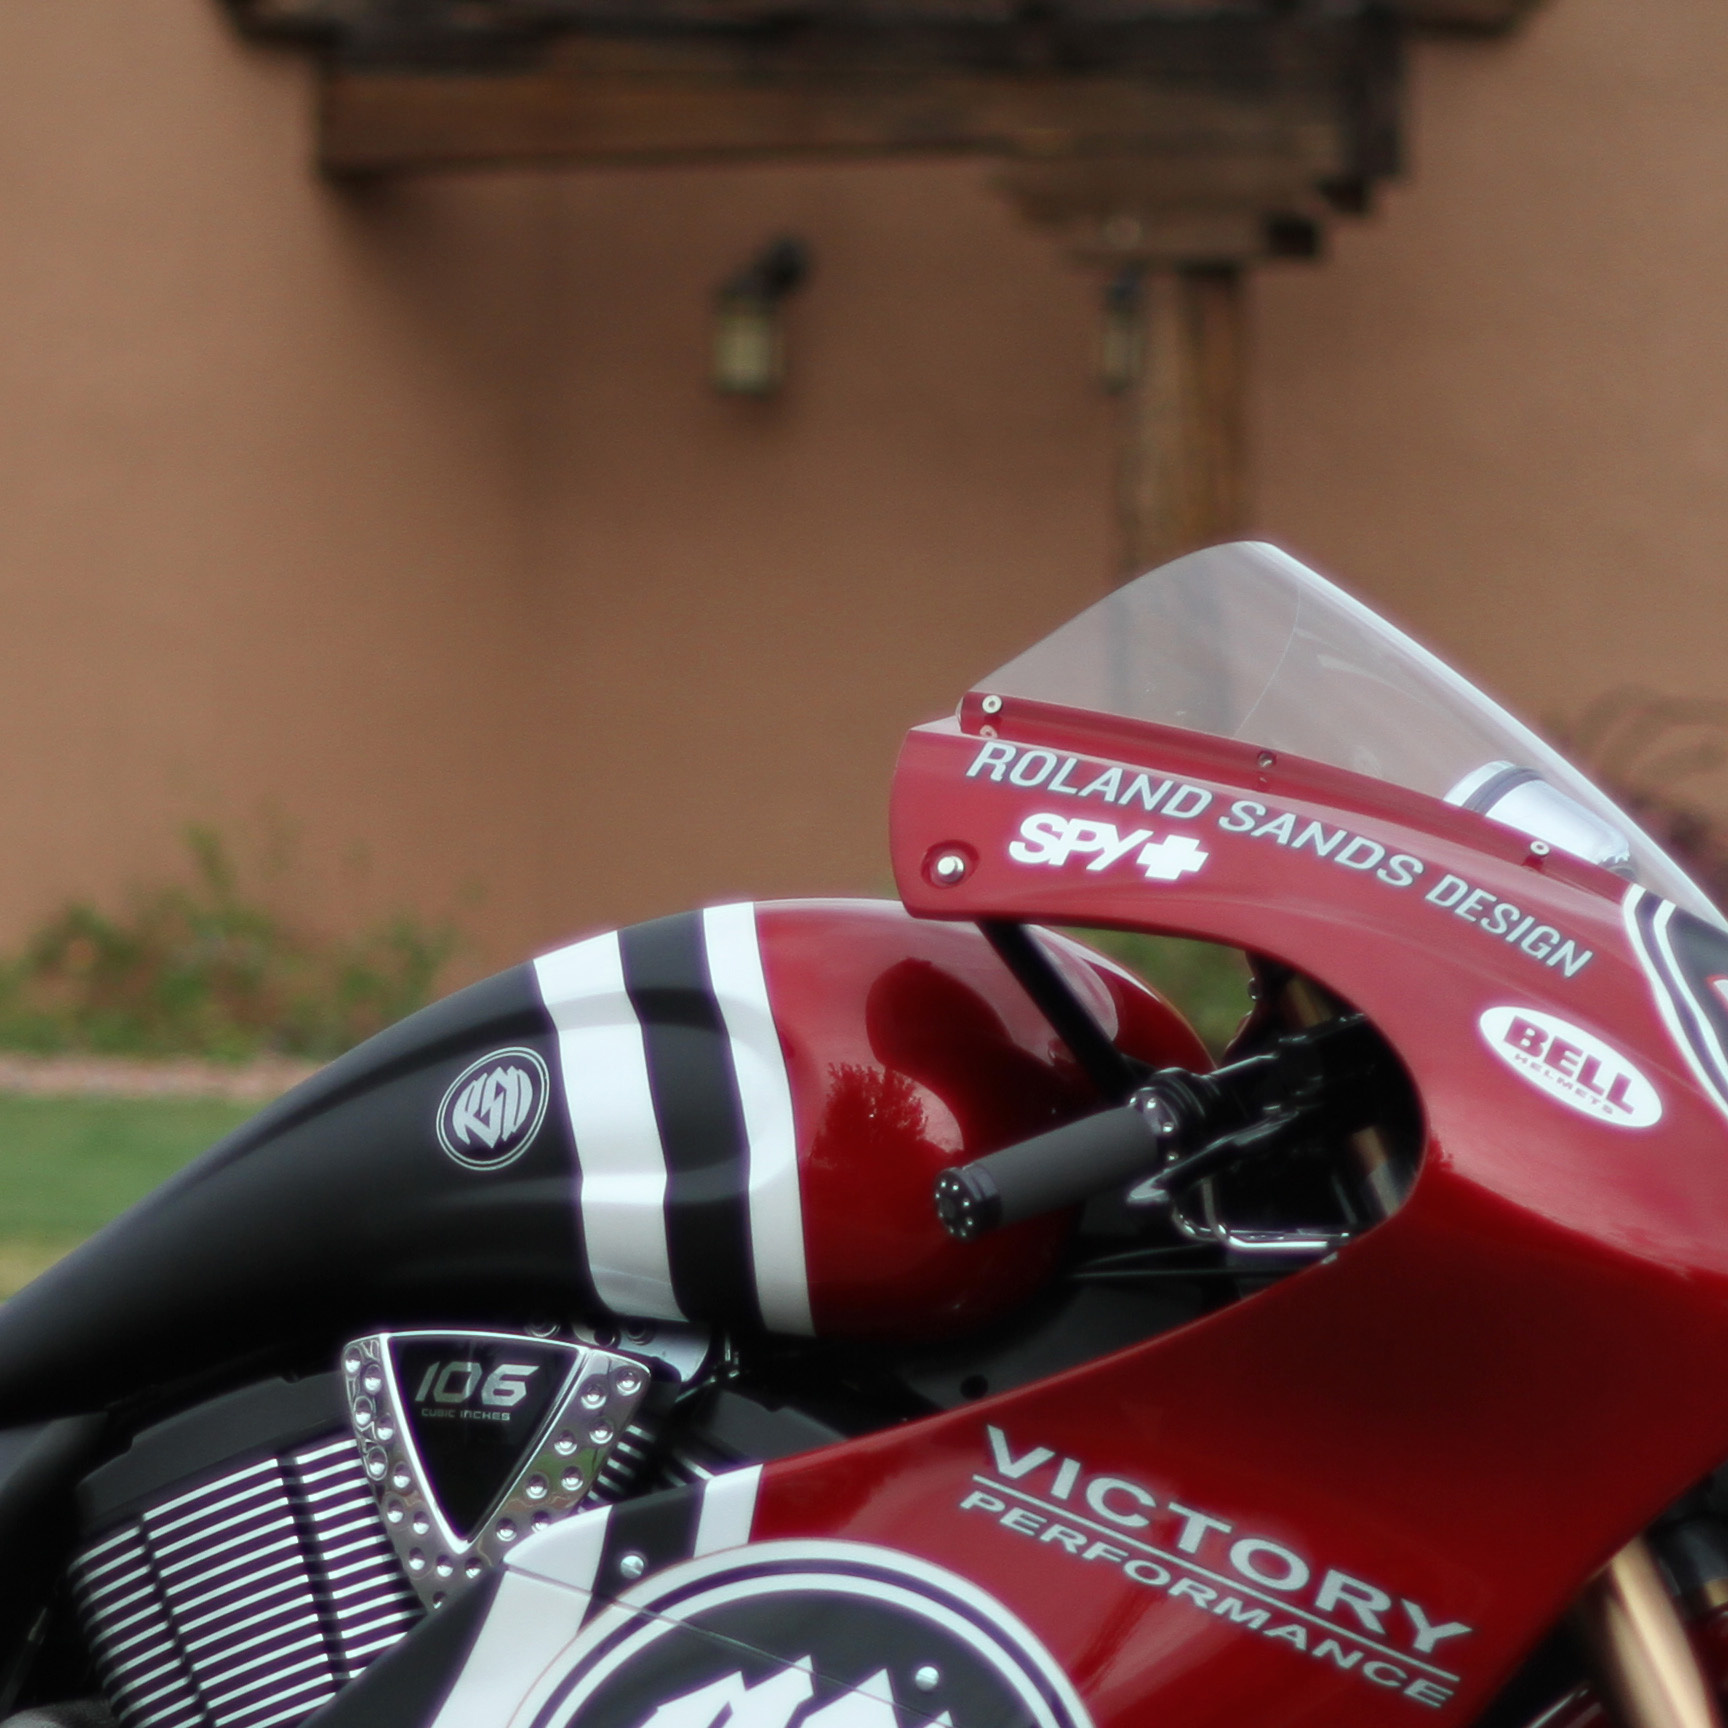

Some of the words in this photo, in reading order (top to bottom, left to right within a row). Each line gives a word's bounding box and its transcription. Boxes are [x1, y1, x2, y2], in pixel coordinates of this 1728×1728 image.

[966, 741, 1213, 819] ROLAND
[1218, 800, 1424, 887] SANDS
[1424, 874, 1593, 978] DESIGN
[1504, 1015, 1634, 1115] BELL
[1515, 1054, 1613, 1114] HELMETS
[415, 1361, 540, 1406] 106
[422, 1408, 455, 1418] CUBIC
[460, 1409, 511, 1421] INCHES
[987, 1425, 1472, 1655] VICTORY
[960, 1491, 1454, 1708] PERFORMANCE
